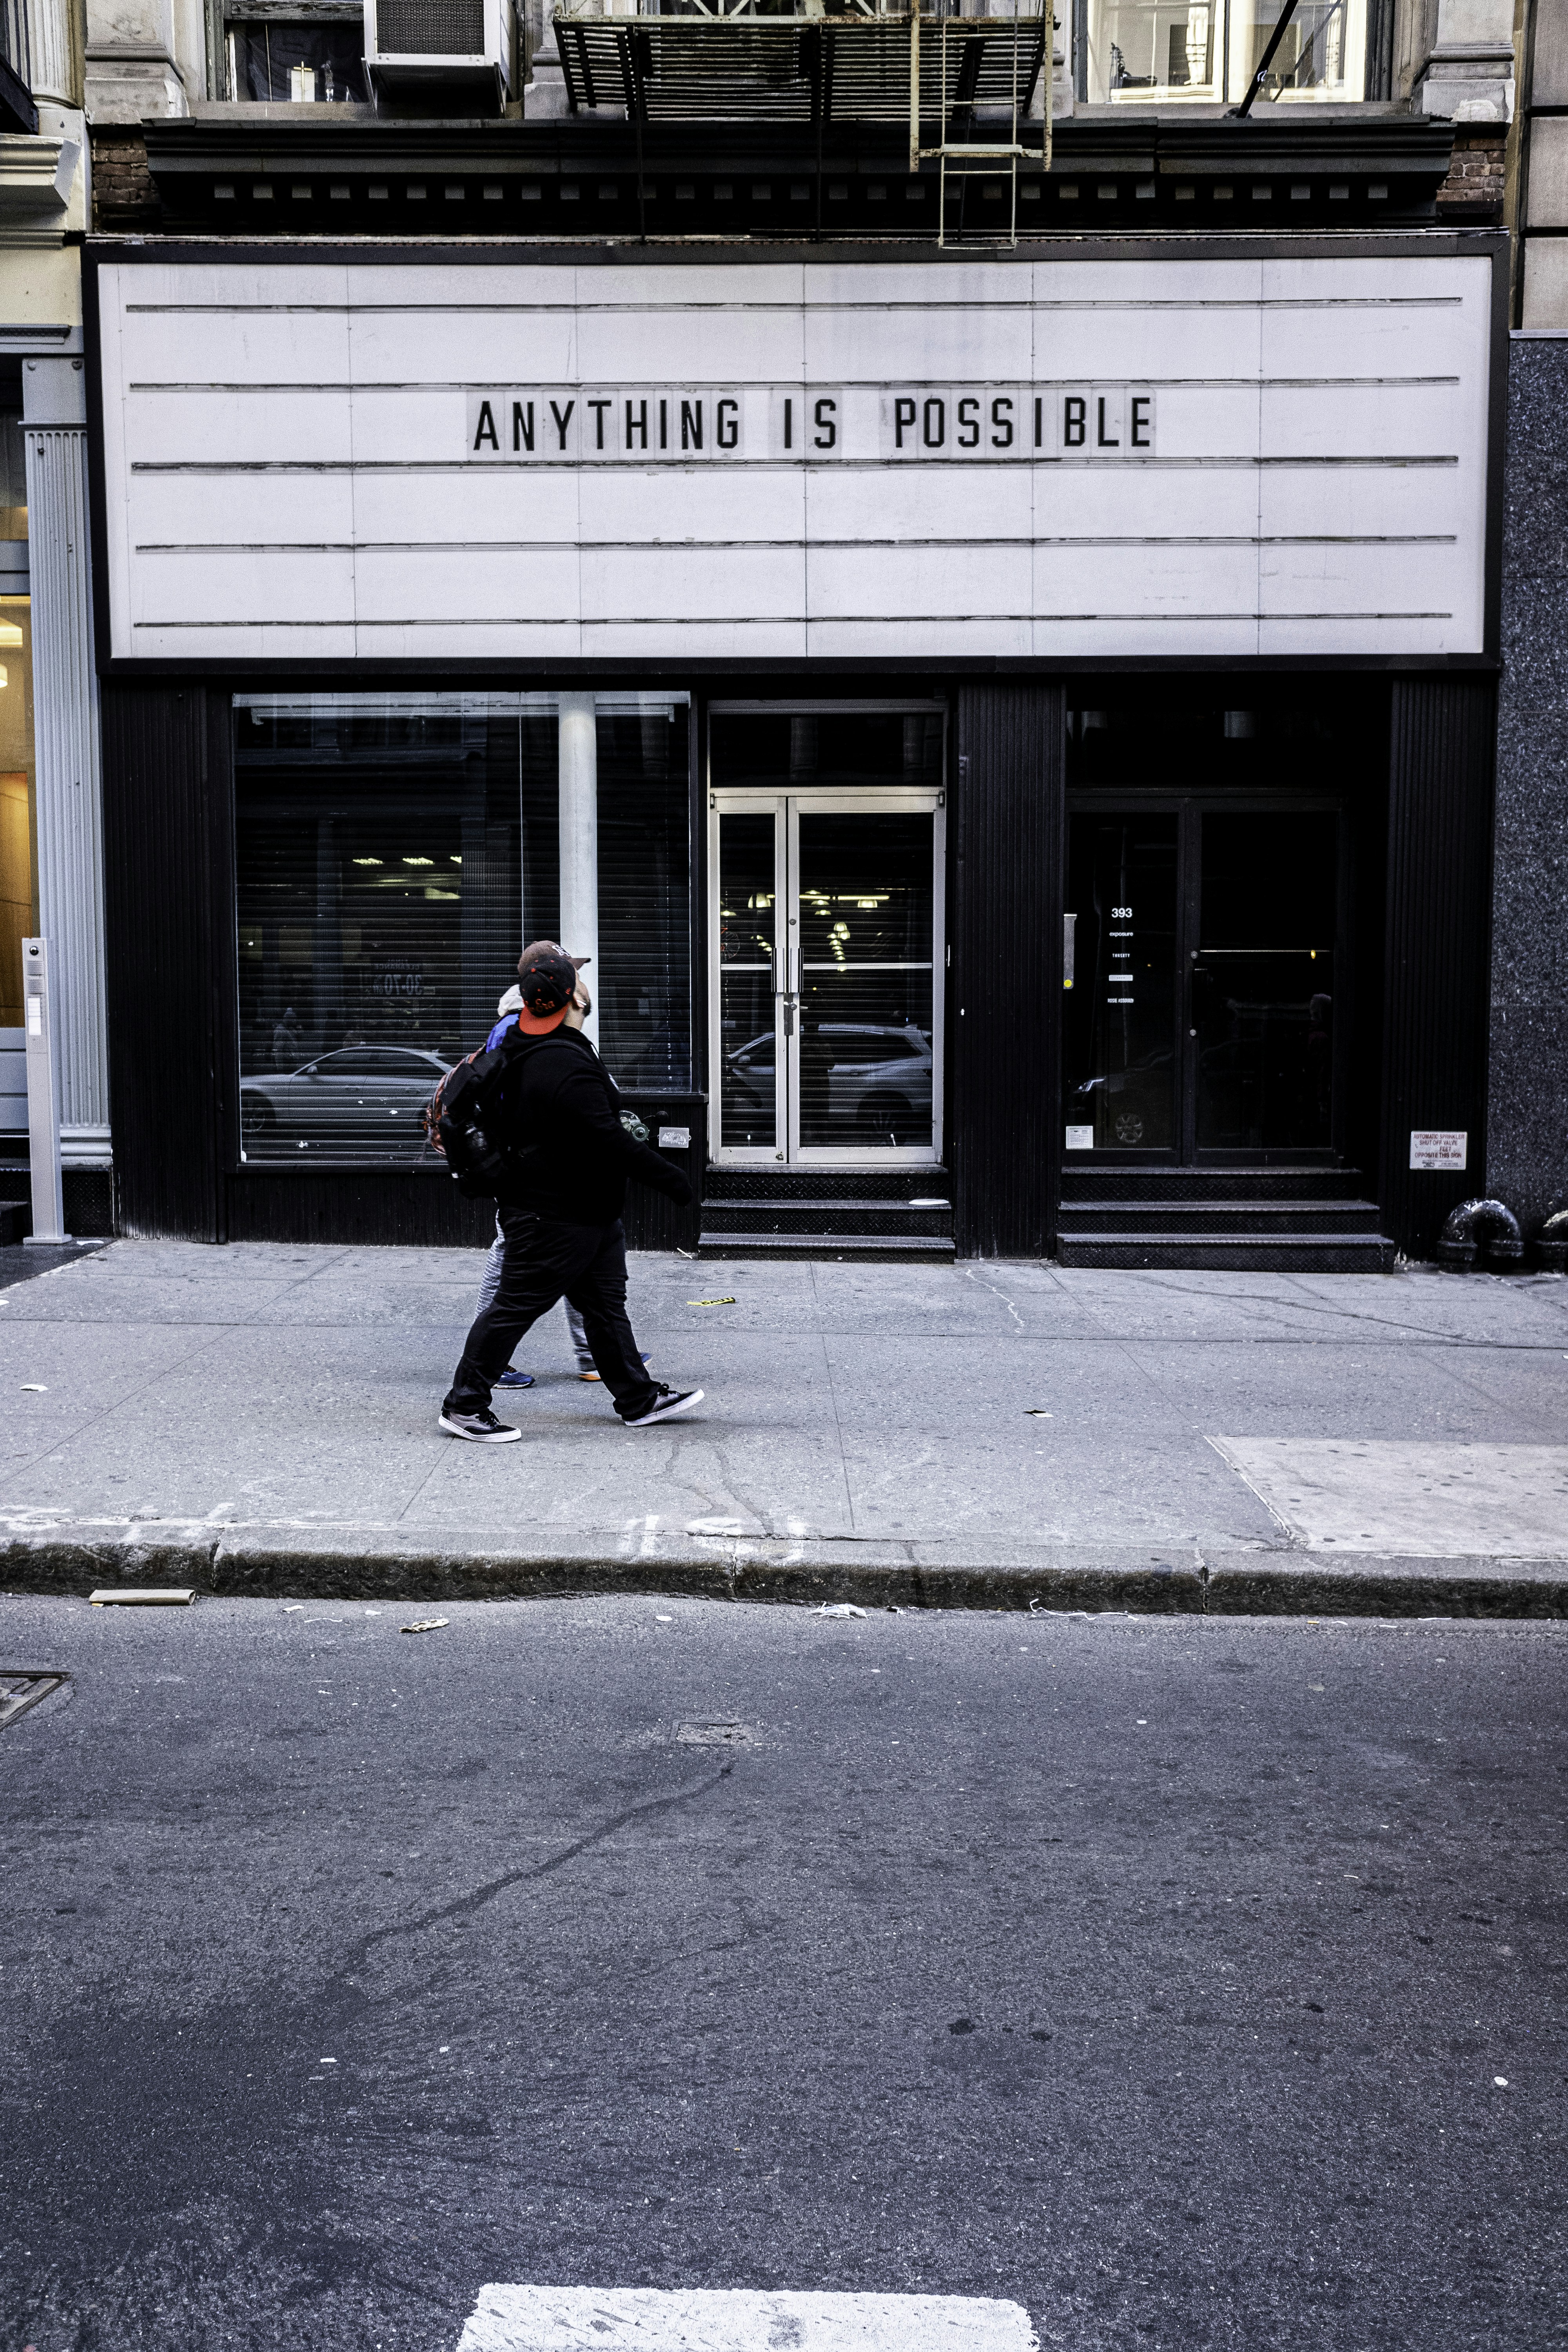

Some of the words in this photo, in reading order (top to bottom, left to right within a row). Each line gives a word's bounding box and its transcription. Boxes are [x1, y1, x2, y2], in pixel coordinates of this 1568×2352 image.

[474, 399, 738, 451] ANYTHING
[785, 399, 836, 448] IS
[895, 397, 1150, 448] POSSIBLE
[1112, 908, 1132, 918] 393
